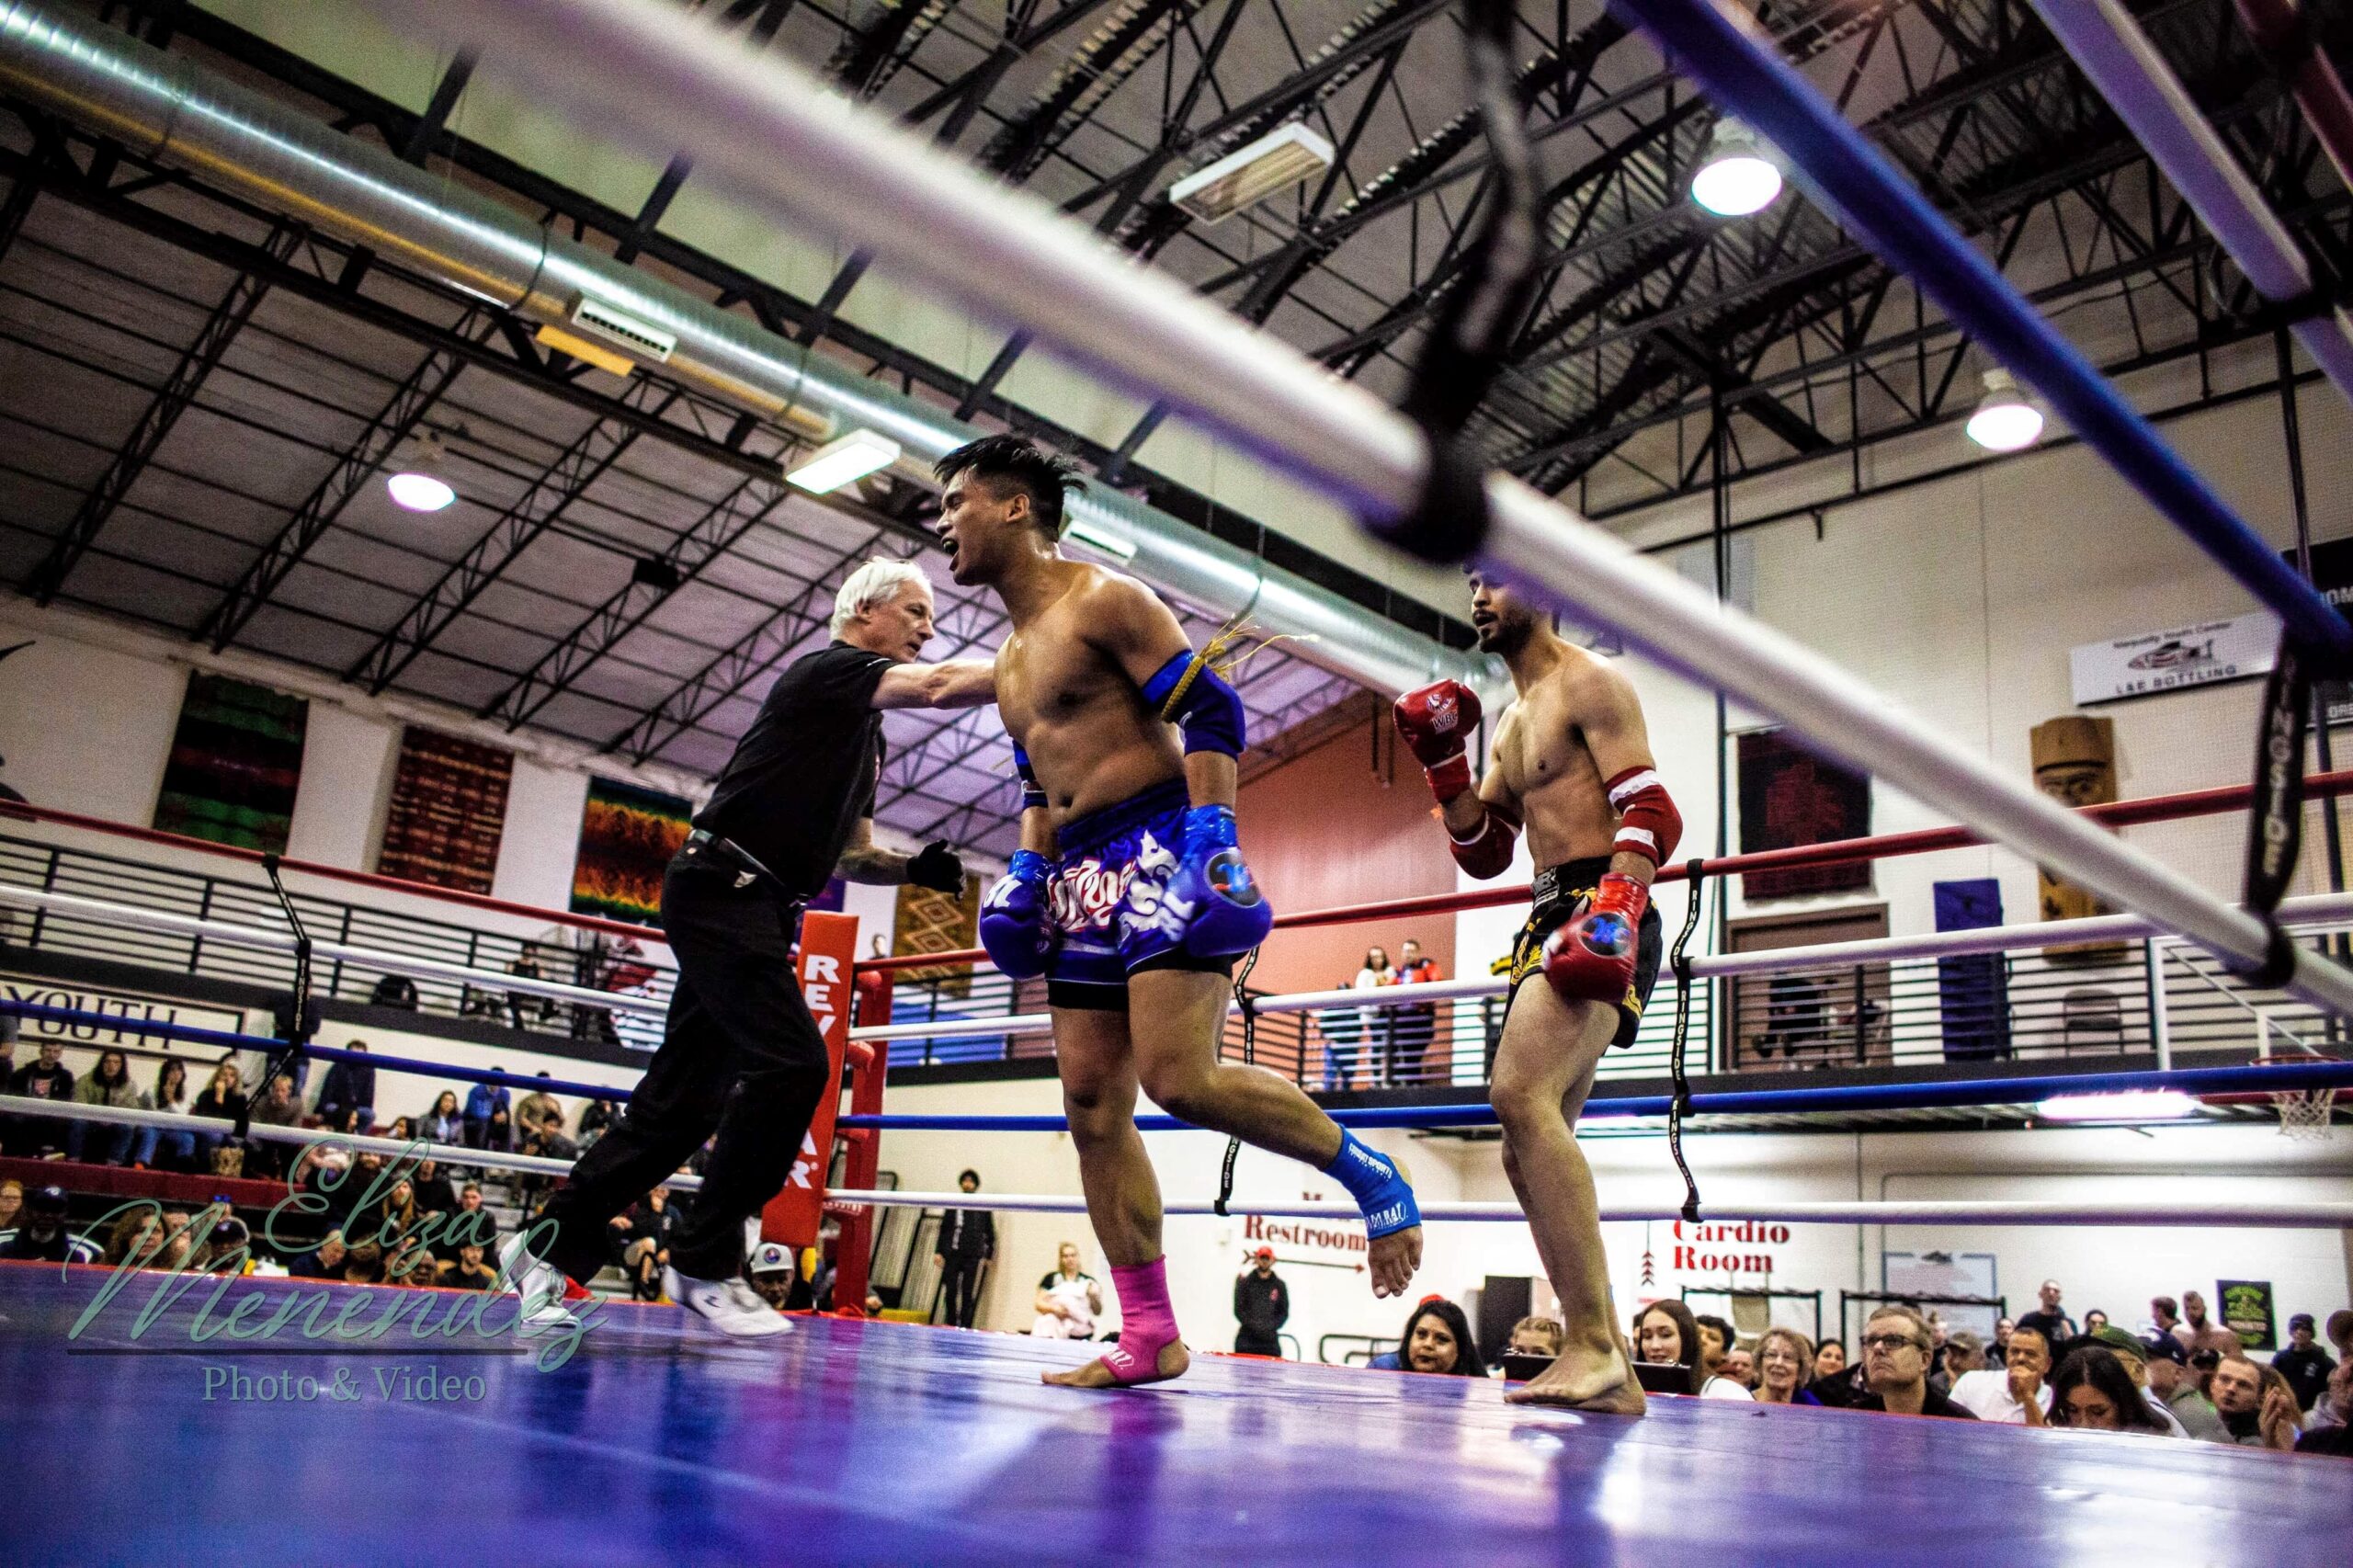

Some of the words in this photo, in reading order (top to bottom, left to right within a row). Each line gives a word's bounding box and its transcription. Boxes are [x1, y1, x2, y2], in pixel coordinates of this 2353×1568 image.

[2116, 678, 2147, 695] L&E
[2153, 664, 2238, 687] BOTTLING
[1673, 890, 1698, 968] RINGSIDE
[293, 958, 307, 1032] RINGSIDE
[1236, 948, 1256, 1005] INGSIDE
[5, 985, 176, 1050] YOUTH
[1673, 990, 1688, 1081] RINGSIDE
[1670, 1099, 1694, 1188] RINGSIDE
[1245, 1212, 1366, 1252] Restroom
[1673, 1219, 1790, 1244] Cardio
[1673, 1245, 1774, 1274] Room
